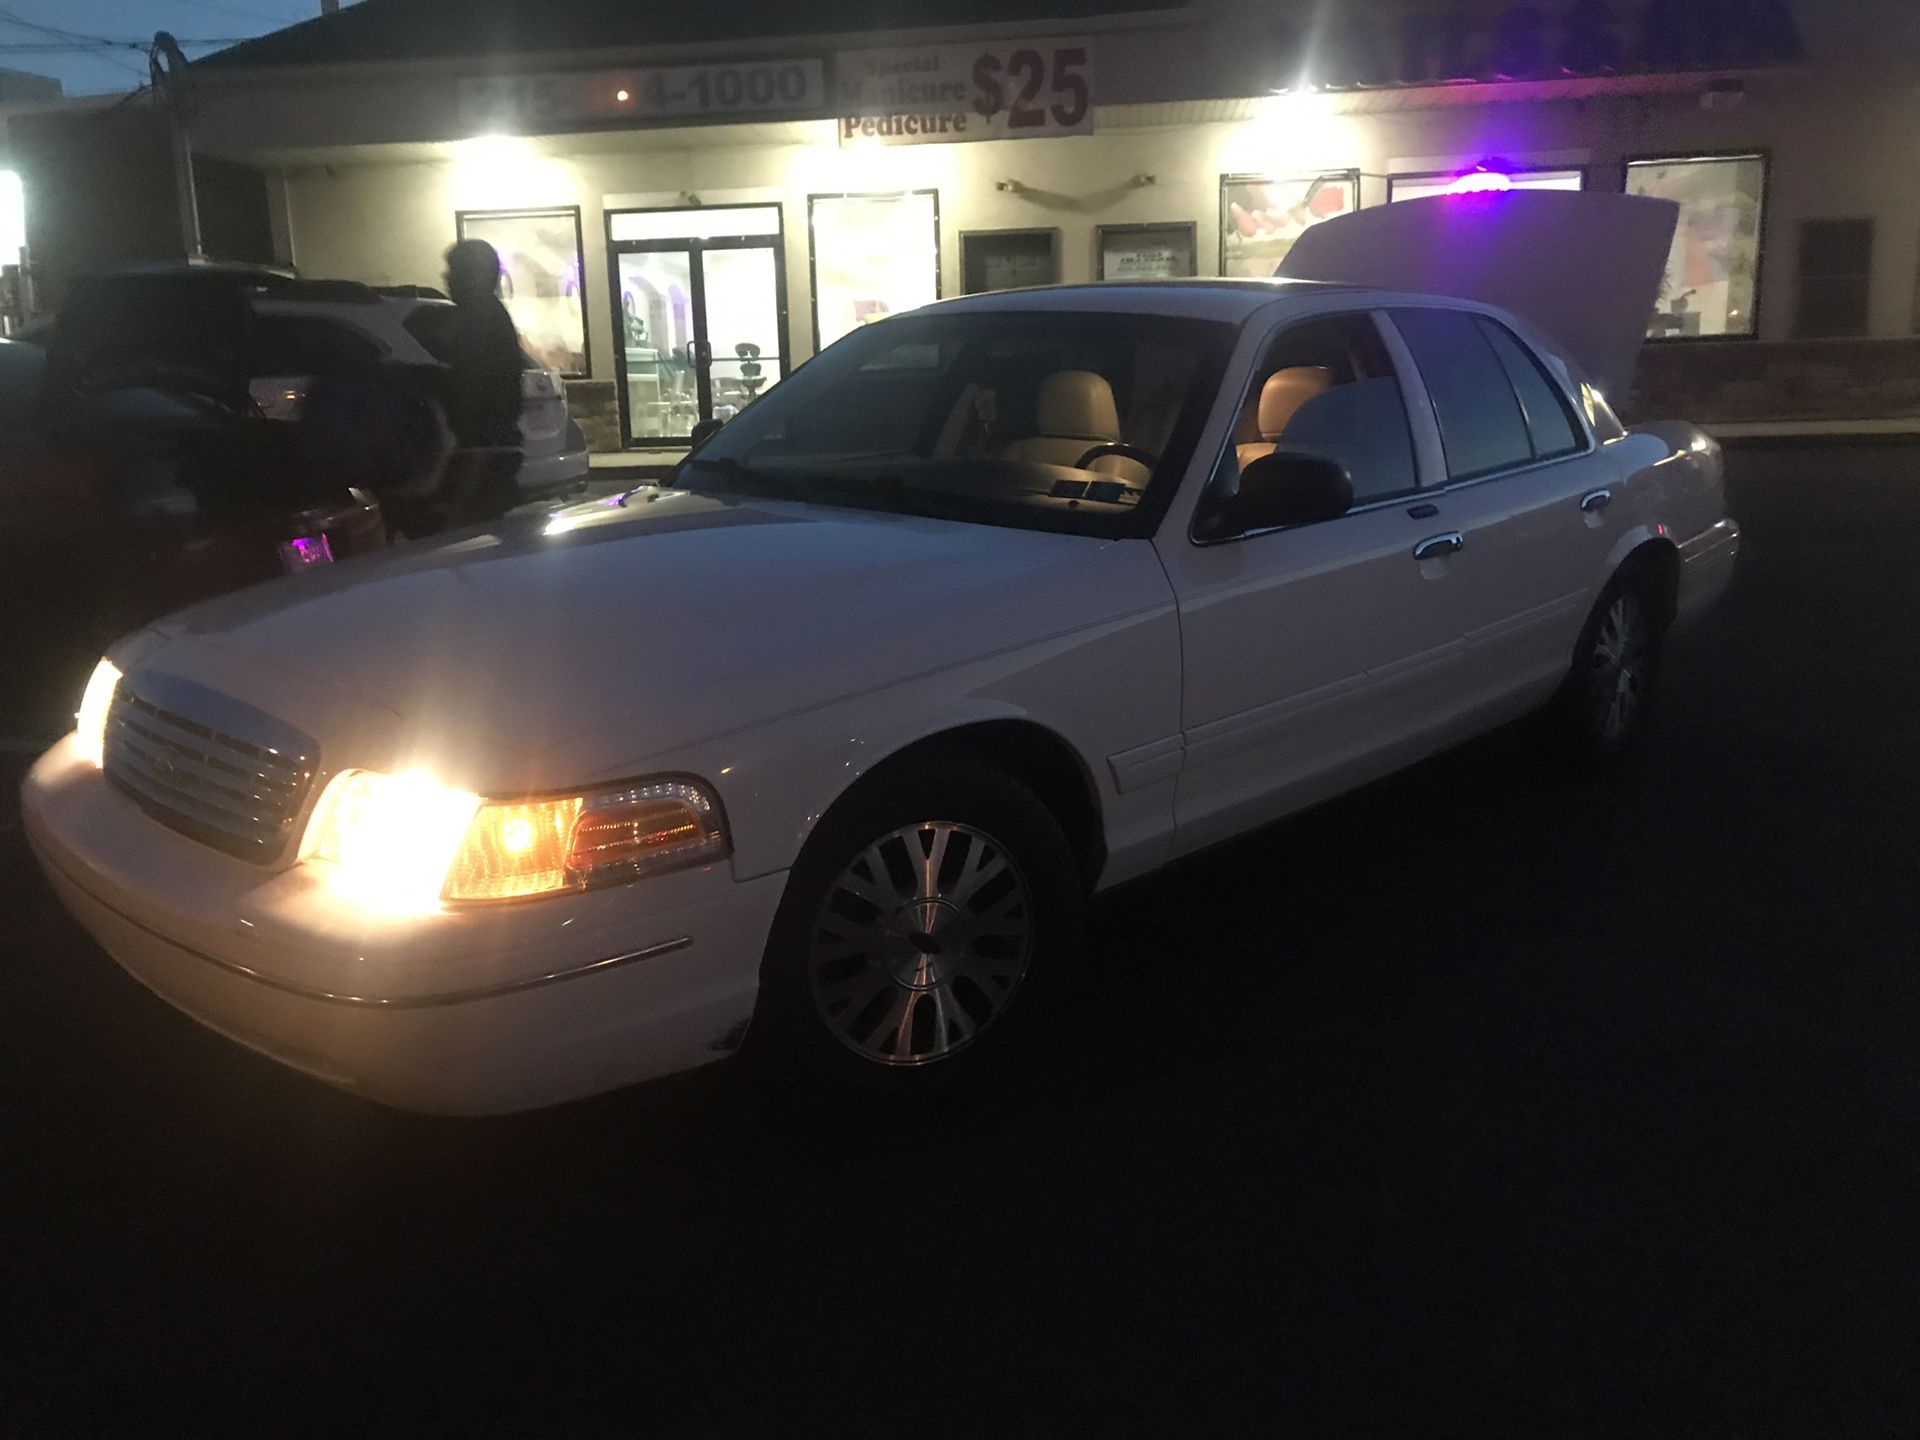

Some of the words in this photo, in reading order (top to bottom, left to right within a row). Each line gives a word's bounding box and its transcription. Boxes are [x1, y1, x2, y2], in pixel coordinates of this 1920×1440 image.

[865, 54, 940, 76] Special
[972, 47, 1089, 129] $25
[844, 112, 968, 139] Pedicure
